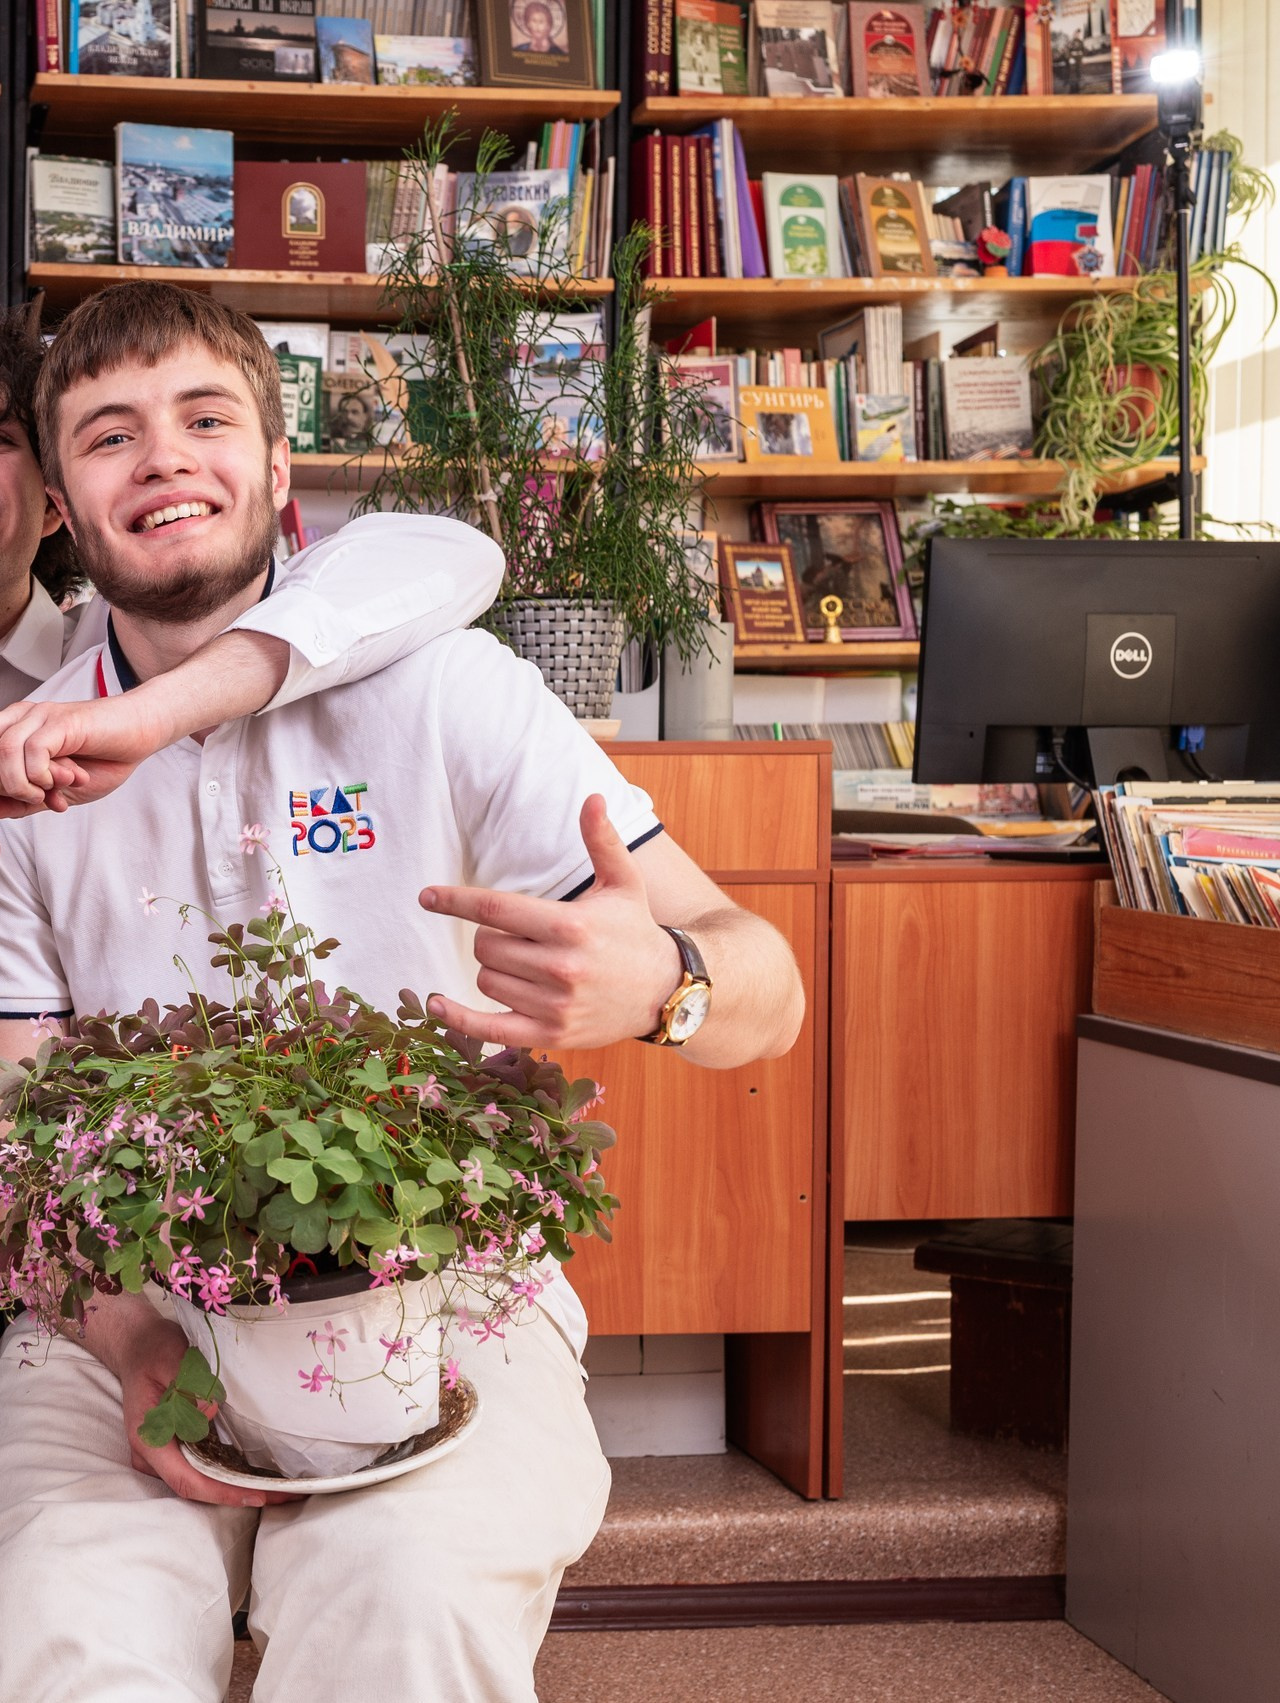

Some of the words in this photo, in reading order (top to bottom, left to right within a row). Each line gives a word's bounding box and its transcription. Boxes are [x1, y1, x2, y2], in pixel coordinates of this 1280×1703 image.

[128, 220, 230, 243] ВЛАДИМИР
[738, 391, 825, 409] СУНГИРЬ
[1114, 648, 1148, 663] DELL
[291, 814, 376, 856] 2023
